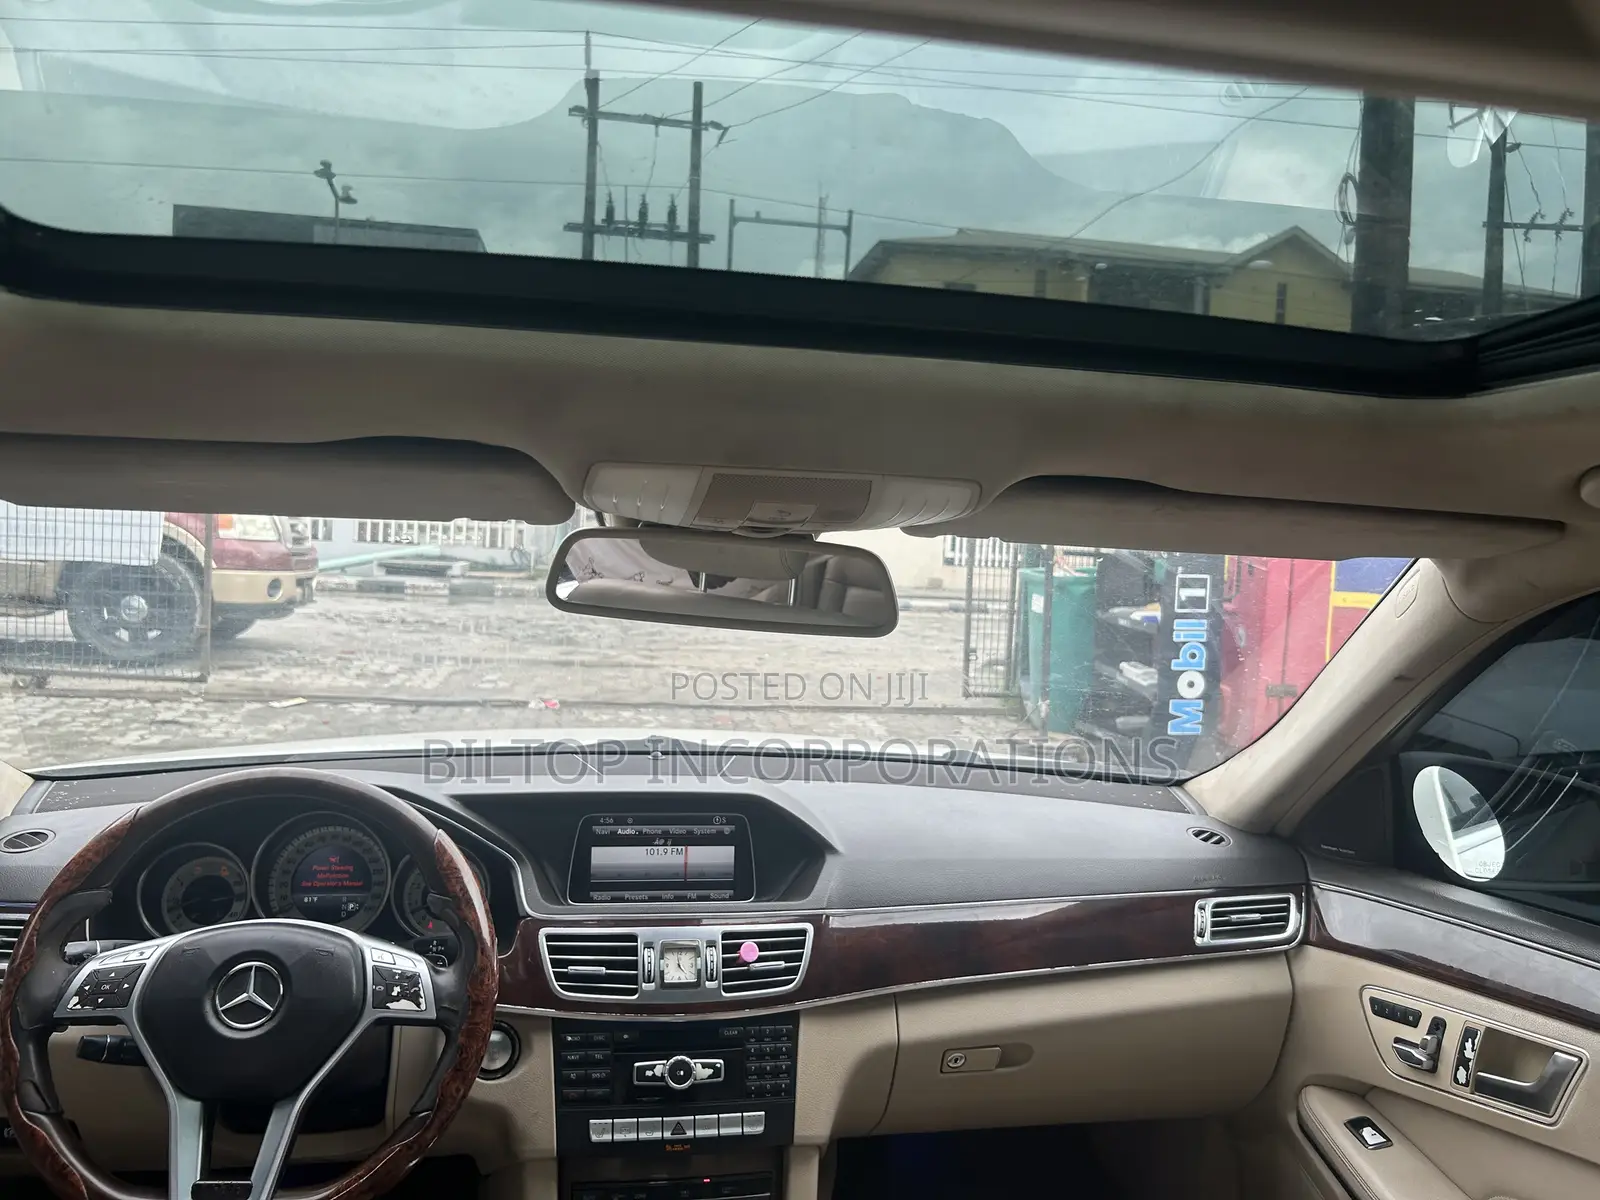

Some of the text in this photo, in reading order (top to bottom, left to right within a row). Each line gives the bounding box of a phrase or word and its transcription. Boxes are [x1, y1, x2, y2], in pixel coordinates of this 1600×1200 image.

[1168, 619, 1208, 735] Mobil
[599, 816, 614, 824] 4:56
[595, 828, 611, 836] Navi
[617, 828, 637, 836] Audio
[642, 828, 663, 836] Phone
[669, 828, 687, 836] Video
[693, 828, 717, 836] System
[645, 847, 684, 856] 101.9 FM
[624, 893, 649, 901] Presets
